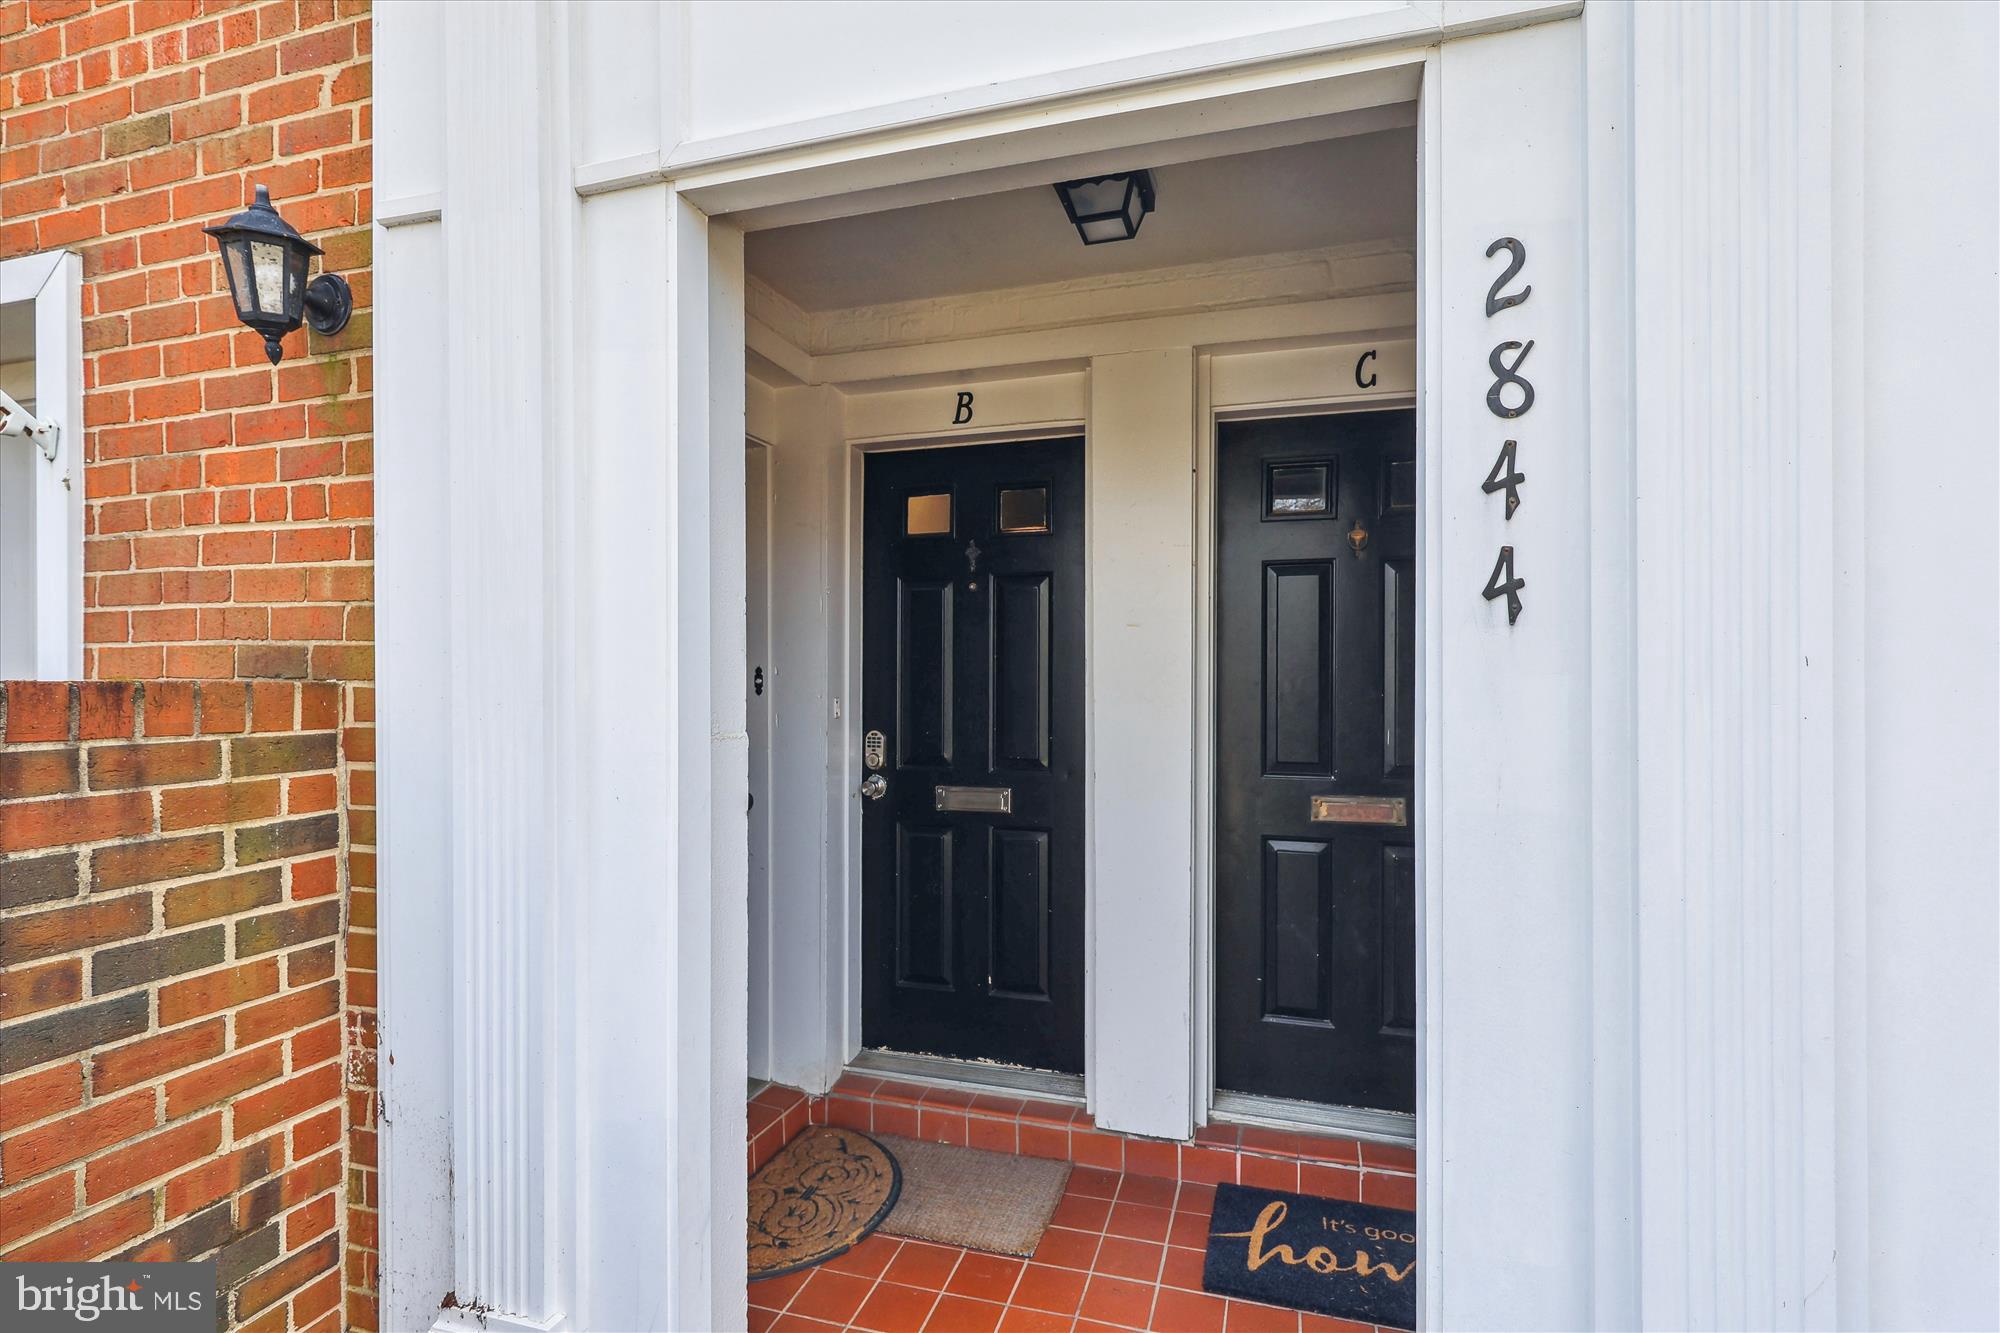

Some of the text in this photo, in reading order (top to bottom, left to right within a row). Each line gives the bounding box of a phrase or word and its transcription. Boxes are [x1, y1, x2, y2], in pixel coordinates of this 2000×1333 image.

[1355, 350, 1378, 389] C
[952, 391, 974, 424] B
[1481, 237, 1535, 625] 2844
[1322, 1217, 1416, 1244] It's goo
